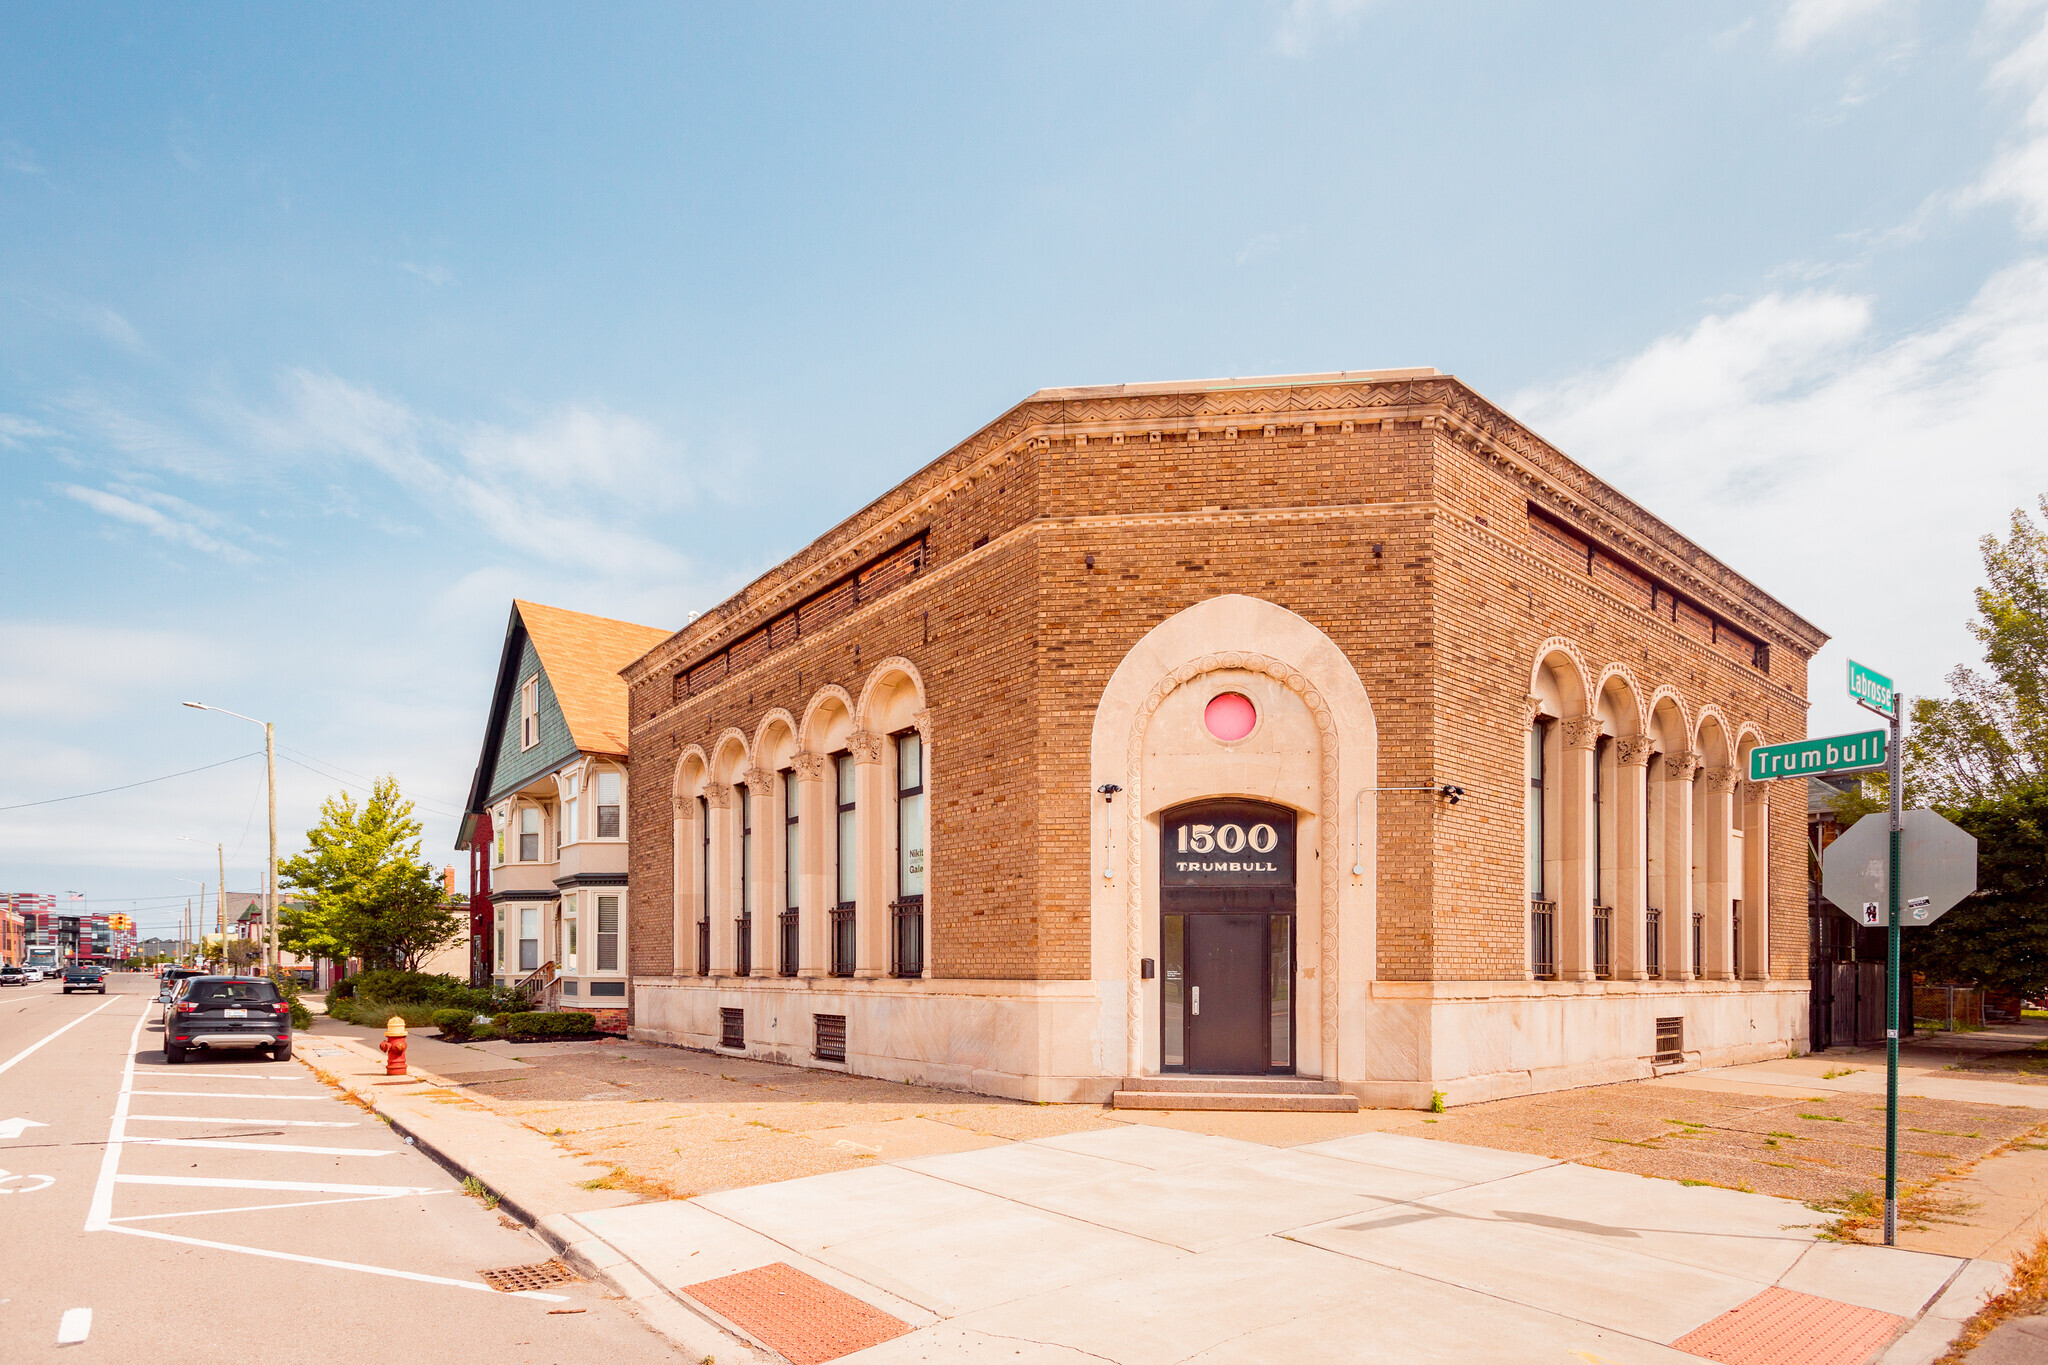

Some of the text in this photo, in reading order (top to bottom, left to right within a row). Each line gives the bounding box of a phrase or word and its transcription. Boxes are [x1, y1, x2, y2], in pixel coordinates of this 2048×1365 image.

[1850, 666, 1892, 707] Labrosse
[1758, 736, 1878, 774] Trumbull
[1177, 823, 1278, 854] 1500
[1175, 862, 1278, 872] TRUMBULL
